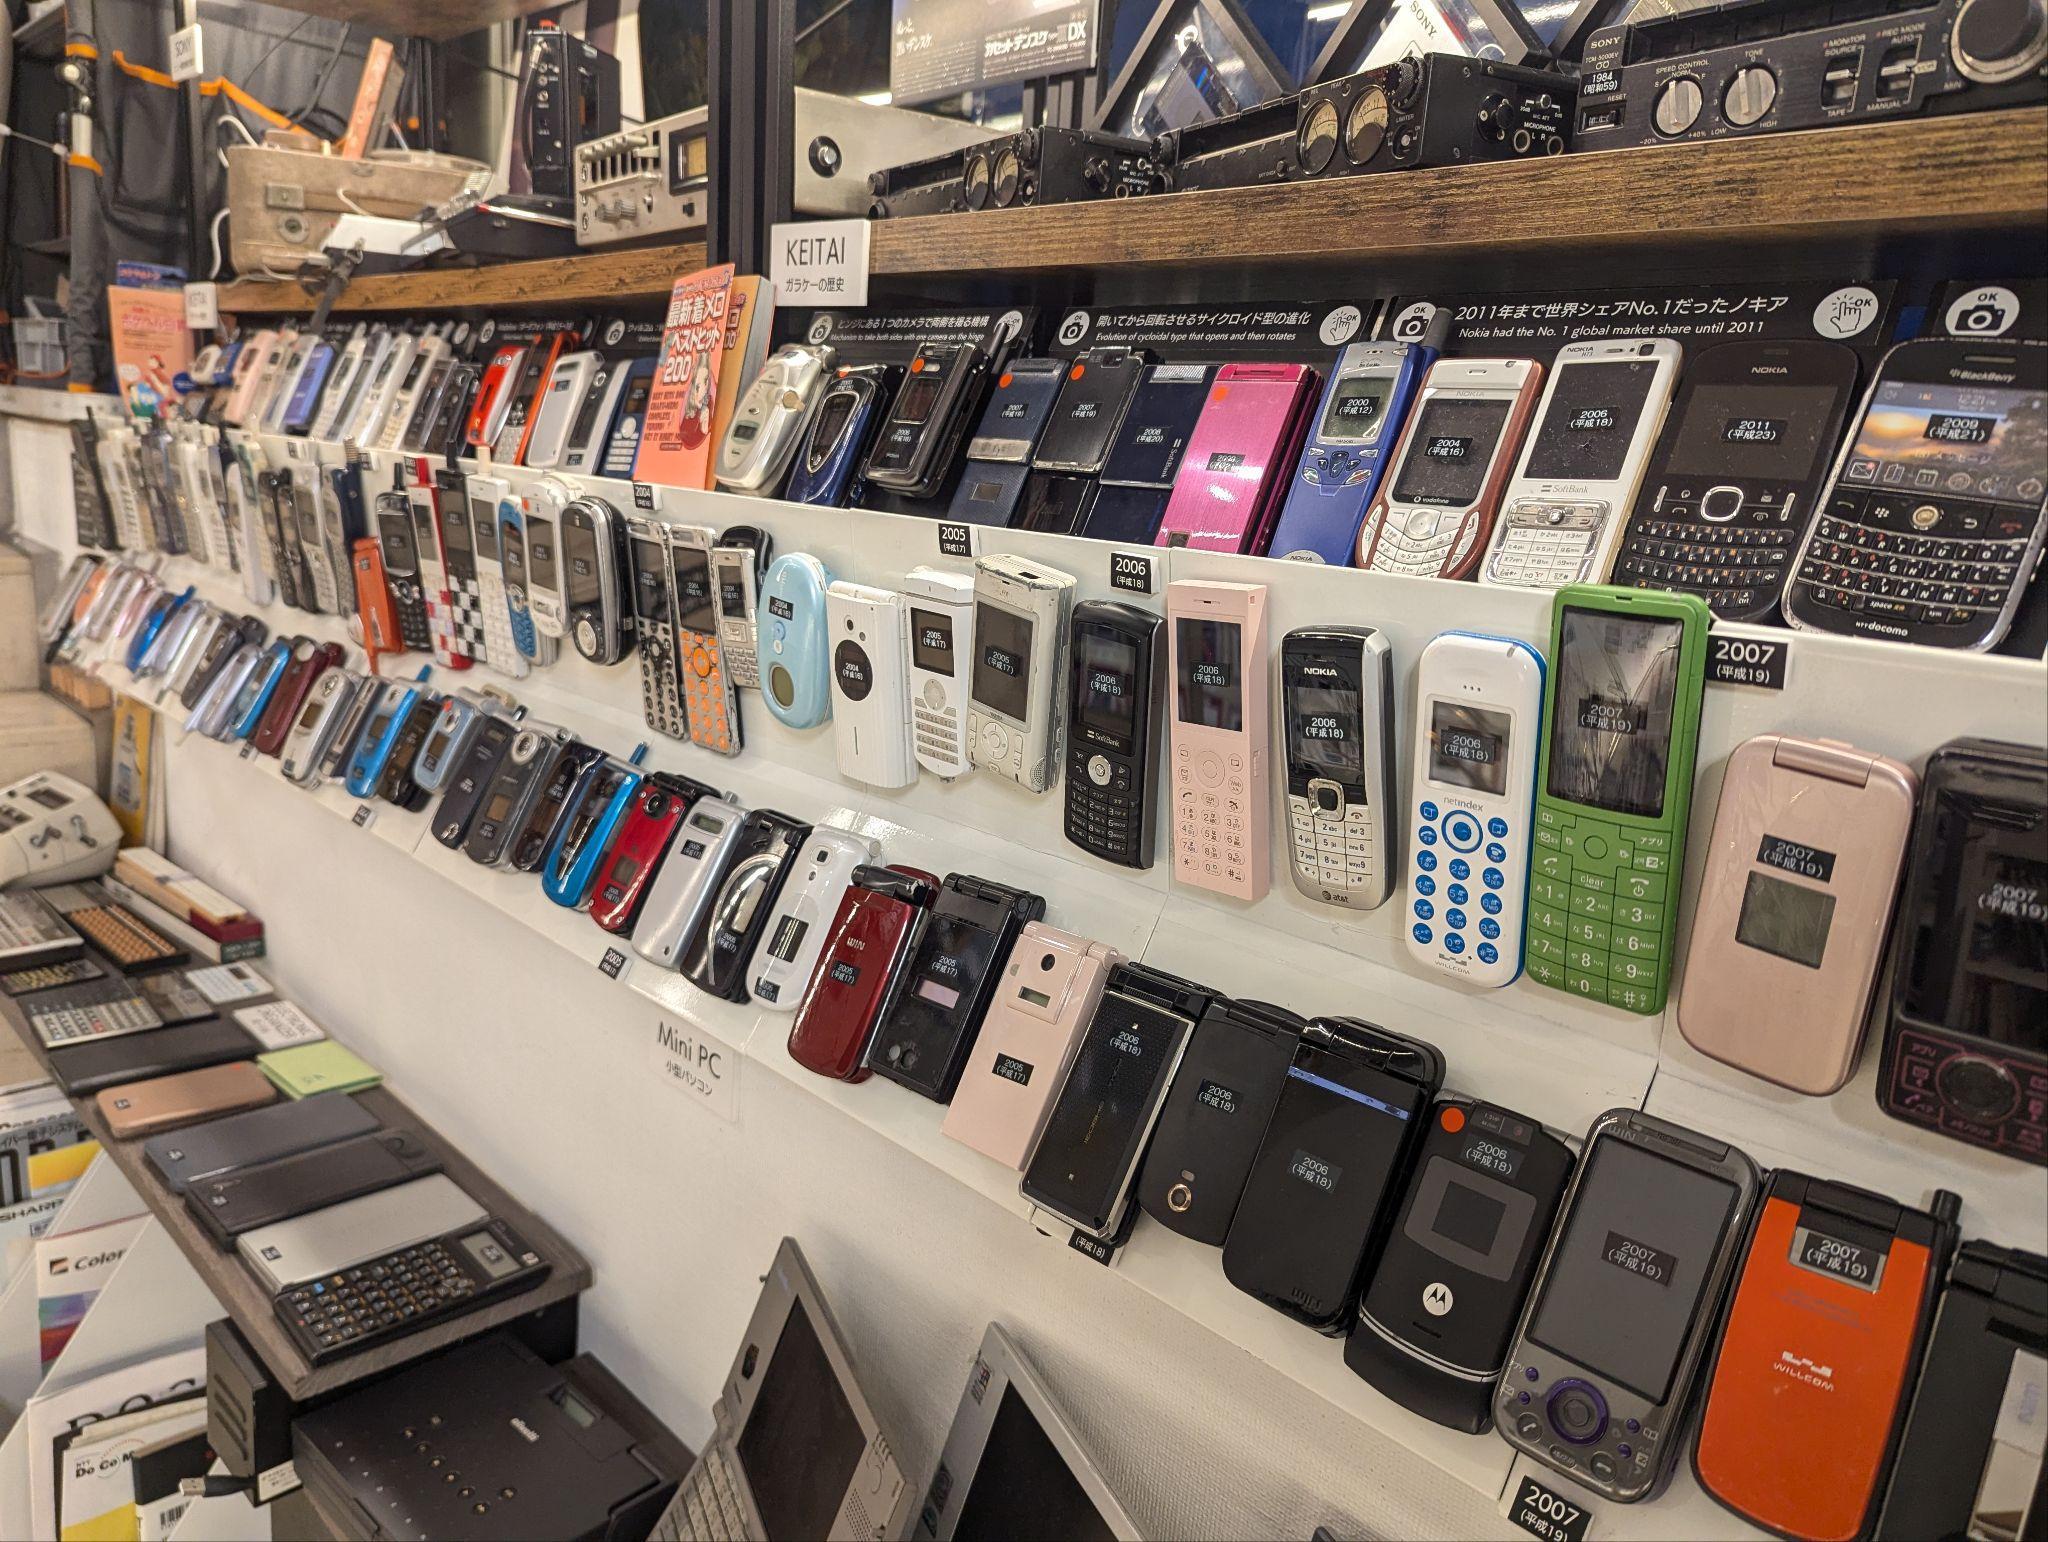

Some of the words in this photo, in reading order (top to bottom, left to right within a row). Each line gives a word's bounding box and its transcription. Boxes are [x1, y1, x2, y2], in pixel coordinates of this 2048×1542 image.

[1410, 1, 1438, 39] SONY
[1067, 21, 1087, 40] DX
[1591, 37, 1621, 49] SONY
[1829, 34, 1866, 46] MONITOR
[1745, 49, 1764, 57] TONE
[1825, 46, 1856, 56] SOURCE
[1656, 65, 1676, 75] SPEED
[1677, 60, 1709, 70] CONTROL
[1592, 72, 1613, 81] 1984
[1583, 80, 1618, 94] (昭和59)
[1867, 100, 1901, 111] MANUAL
[1828, 109, 1845, 117] TAPE
[1524, 122, 1556, 132] MICROPHONE
[1711, 128, 1727, 136] LOW
[786, 237, 846, 267] KEITAI
[786, 277, 845, 292] ガラケーの歴史
[1854, 299, 1873, 307] OK
[1978, 293, 1998, 302] OK
[667, 292, 727, 327] 最新着メロ
[1454, 296, 1789, 321] 2011年まで世界シェアNo.1だったノキア
[1096, 312, 1311, 327] 開いてから回転させるサイクロイド型の進化
[1459, 329, 1490, 338] Nokia
[1492, 328, 1514, 337] had
[1517, 327, 1534, 337] the
[1538, 326, 1557, 337] No.
[1563, 326, 1568, 337] 1
[1571, 325, 1609, 338] global
[1612, 324, 1654, 335] market
[1658, 324, 1691, 334] share
[1695, 323, 1724, 334] until
[1727, 321, 1764, 333] 2011
[672, 326, 721, 352] ベストヒット
[968, 333, 984, 342] hinge
[1096, 333, 1127, 341] Evolution
[1128, 332, 1136, 341] of
[1138, 332, 1169, 342] cycloidal
[1171, 333, 1187, 342] type
[1189, 333, 1203, 341] that
[1205, 333, 1228, 342] opens
[1230, 332, 1247, 340] and
[1248, 332, 1265, 340] then
[1267, 332, 1296, 340] rotates
[663, 354, 692, 385] 200
[1960, 370, 2015, 382] BlackBerry
[1581, 410, 1608, 419] 2006
[1570, 418, 1613, 428] (平成18)
[1739, 421, 1770, 429] 2011
[1942, 418, 1978, 428] 2009
[1728, 430, 1776, 441] (平成23)
[1929, 427, 1985, 440] (平成21)
[1437, 439, 1460, 447] 2004
[1427, 447, 1464, 456] (平成16)
[636, 486, 651, 498] 2004
[1553, 485, 1589, 494] SoftBank
[1422, 496, 1449, 504] vodafone
[942, 527, 966, 541] 2005
[944, 544, 966, 553] (平成17)
[1115, 558, 1146, 575] 2006
[1116, 576, 1144, 589] (平成18)
[926, 631, 942, 640] 2005
[1868, 621, 1908, 636] docomo
[923, 638, 946, 648] (平成17)
[993, 652, 1010, 663] 2005
[1716, 640, 1775, 664] 2007
[846, 663, 859, 671] 2004
[988, 657, 1014, 673] (平成17)
[1198, 665, 1219, 675] 2006
[1304, 667, 1337, 676] NOKIA
[1095, 674, 1116, 684] 2006
[1193, 673, 1225, 686] (平成18)
[1717, 665, 1770, 683] (平成19)
[1091, 681, 1121, 695] (平成18)
[1590, 705, 1623, 717] 2007
[1311, 718, 1336, 727] 2006
[1581, 714, 1631, 731] (平成19)
[1095, 733, 1119, 747] SoftBank
[1305, 727, 1343, 739] (平成18)
[1453, 736, 1481, 749] 2006
[1444, 742, 1489, 761] (平成18)
[1444, 796, 1483, 811] netindex
[1641, 838, 1663, 846] アプリ
[1776, 841, 1815, 860] 2007
[1764, 851, 1823, 878] (平成19)
[1580, 875, 1604, 887] clear
[1993, 884, 2038, 903] 2007
[1978, 894, 2048, 922] (平成19)
[847, 937, 865, 950] WIN
[606, 951, 623, 966] 2005
[939, 956, 956, 966] 2005
[838, 963, 853, 975] 2005
[931, 962, 958, 976] (平成17)
[1435, 960, 1470, 975] WILLCOM
[831, 970, 854, 985] (平成17)
[1118, 1030, 1140, 1045] 2006
[658, 1021, 693, 1058] Mini
[699, 1051, 722, 1079] PC
[1110, 1037, 1141, 1056] (平成18)
[1004, 1058, 1024, 1072] 2005
[667, 1060, 712, 1096] 小型パソコン
[996, 1064, 1025, 1082] (平成17)
[1208, 1084, 1232, 1100] 2006
[1199, 1091, 1235, 1113] (平成18)
[1609, 1126, 1636, 1140] WIN
[1477, 1141, 1508, 1161] 2006
[1303, 1156, 1329, 1176] 2006
[1466, 1150, 1512, 1174] (平成18)
[1292, 1163, 1332, 1190] (平成18)
[1075, 1235, 1105, 1258] (平成18)
[1620, 1240, 1657, 1262] 2007
[1820, 1239, 1859, 1262] 2007
[75, 1249, 126, 1271] Color
[1608, 1249, 1661, 1280] (平成19)
[1806, 1249, 1868, 1279] (平成19)
[1773, 1362, 1834, 1392] WILLCOM
[75, 1466, 95, 1478] Do
[1526, 1484, 1580, 1527] 2007
